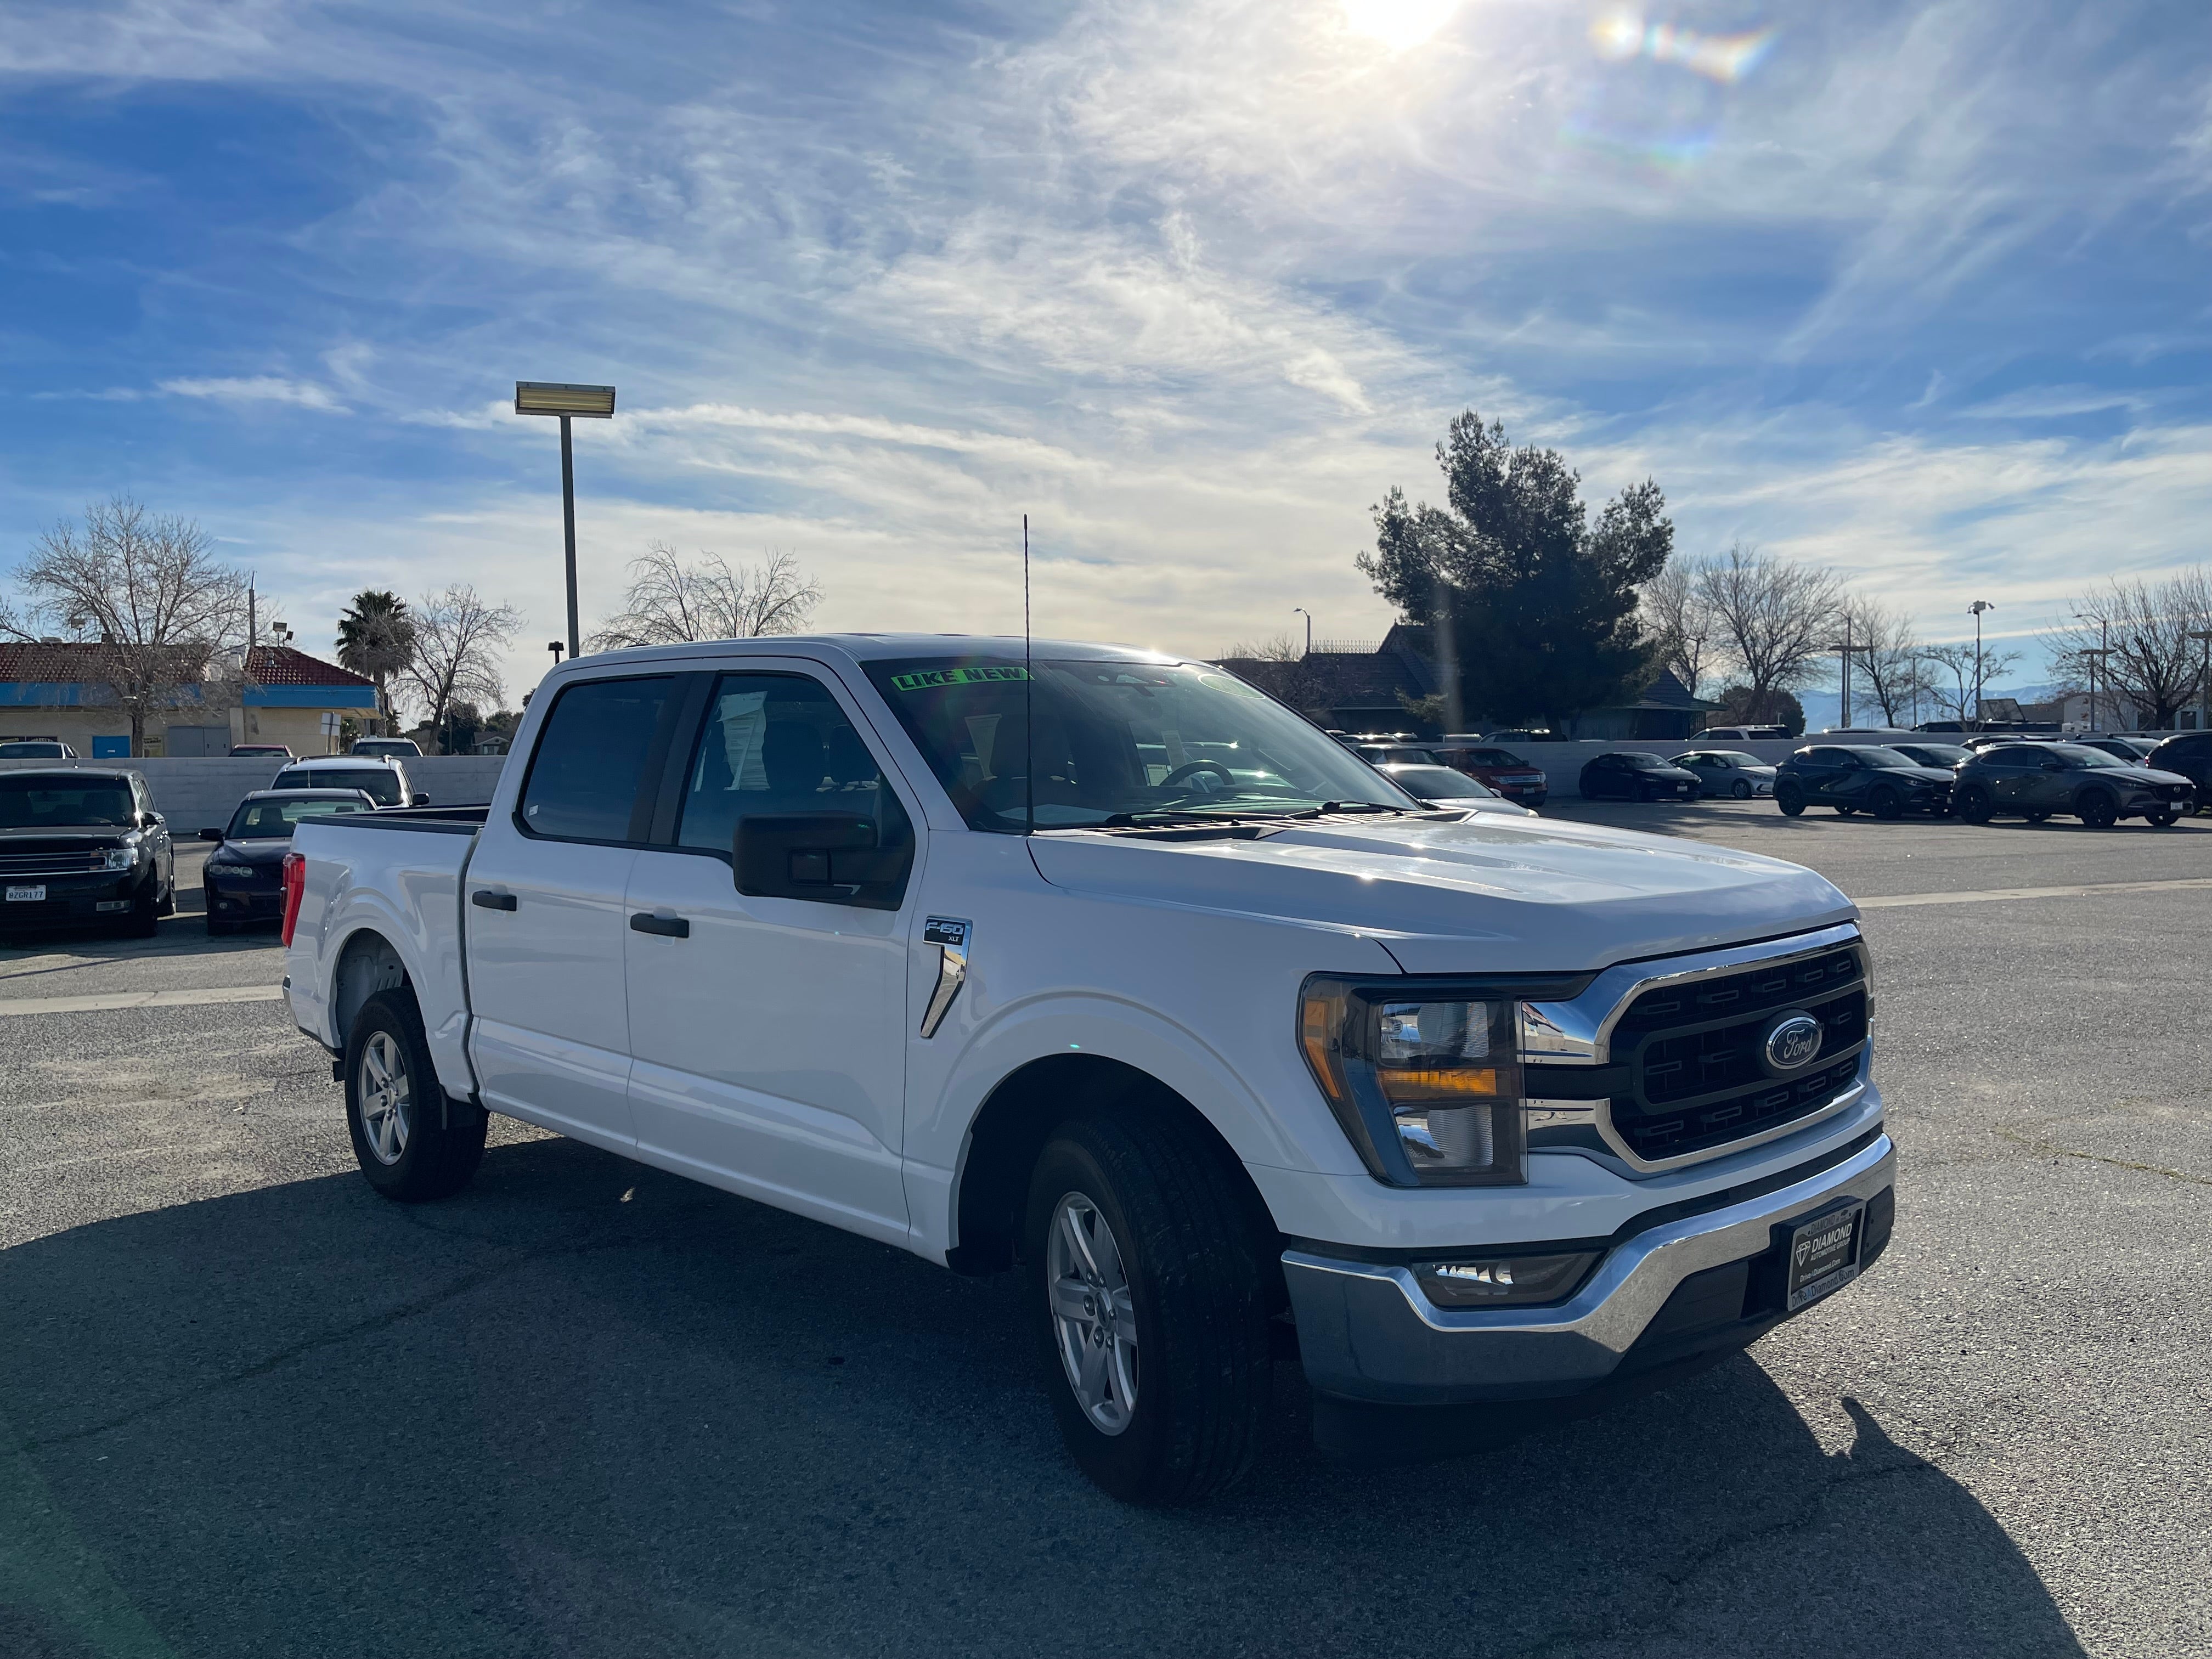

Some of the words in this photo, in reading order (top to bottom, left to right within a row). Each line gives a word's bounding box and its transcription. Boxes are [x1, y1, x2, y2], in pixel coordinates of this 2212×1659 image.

[897, 670, 957, 688] LIKE
[962, 668, 1020, 681] NEW
[926, 921, 964, 935] F-150
[1784, 1029, 1813, 1059] Ford
[1811, 1223, 1853, 1253] DIAMOND
